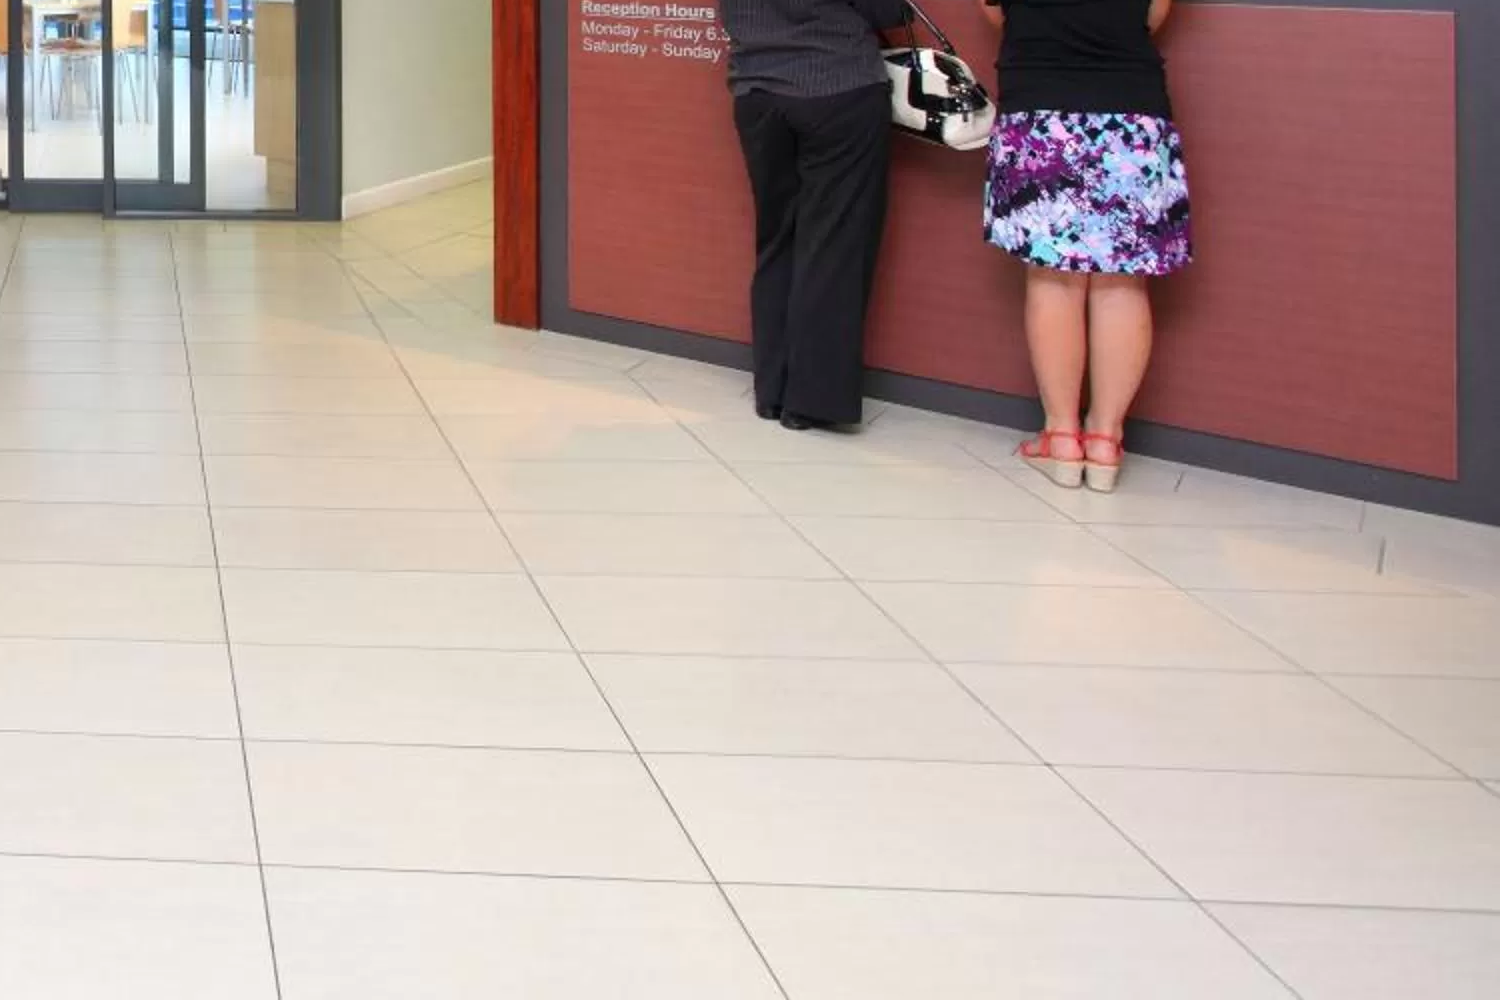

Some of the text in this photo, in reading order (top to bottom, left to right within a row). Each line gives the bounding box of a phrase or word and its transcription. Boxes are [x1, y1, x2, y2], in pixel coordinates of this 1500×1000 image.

[581, 0, 716, 21] Reception Hours
[581, 21, 640, 40] Monday
[654, 24, 702, 43] Friday
[583, 37, 647, 57] Saturday
[663, 43, 721, 63] Sunday
